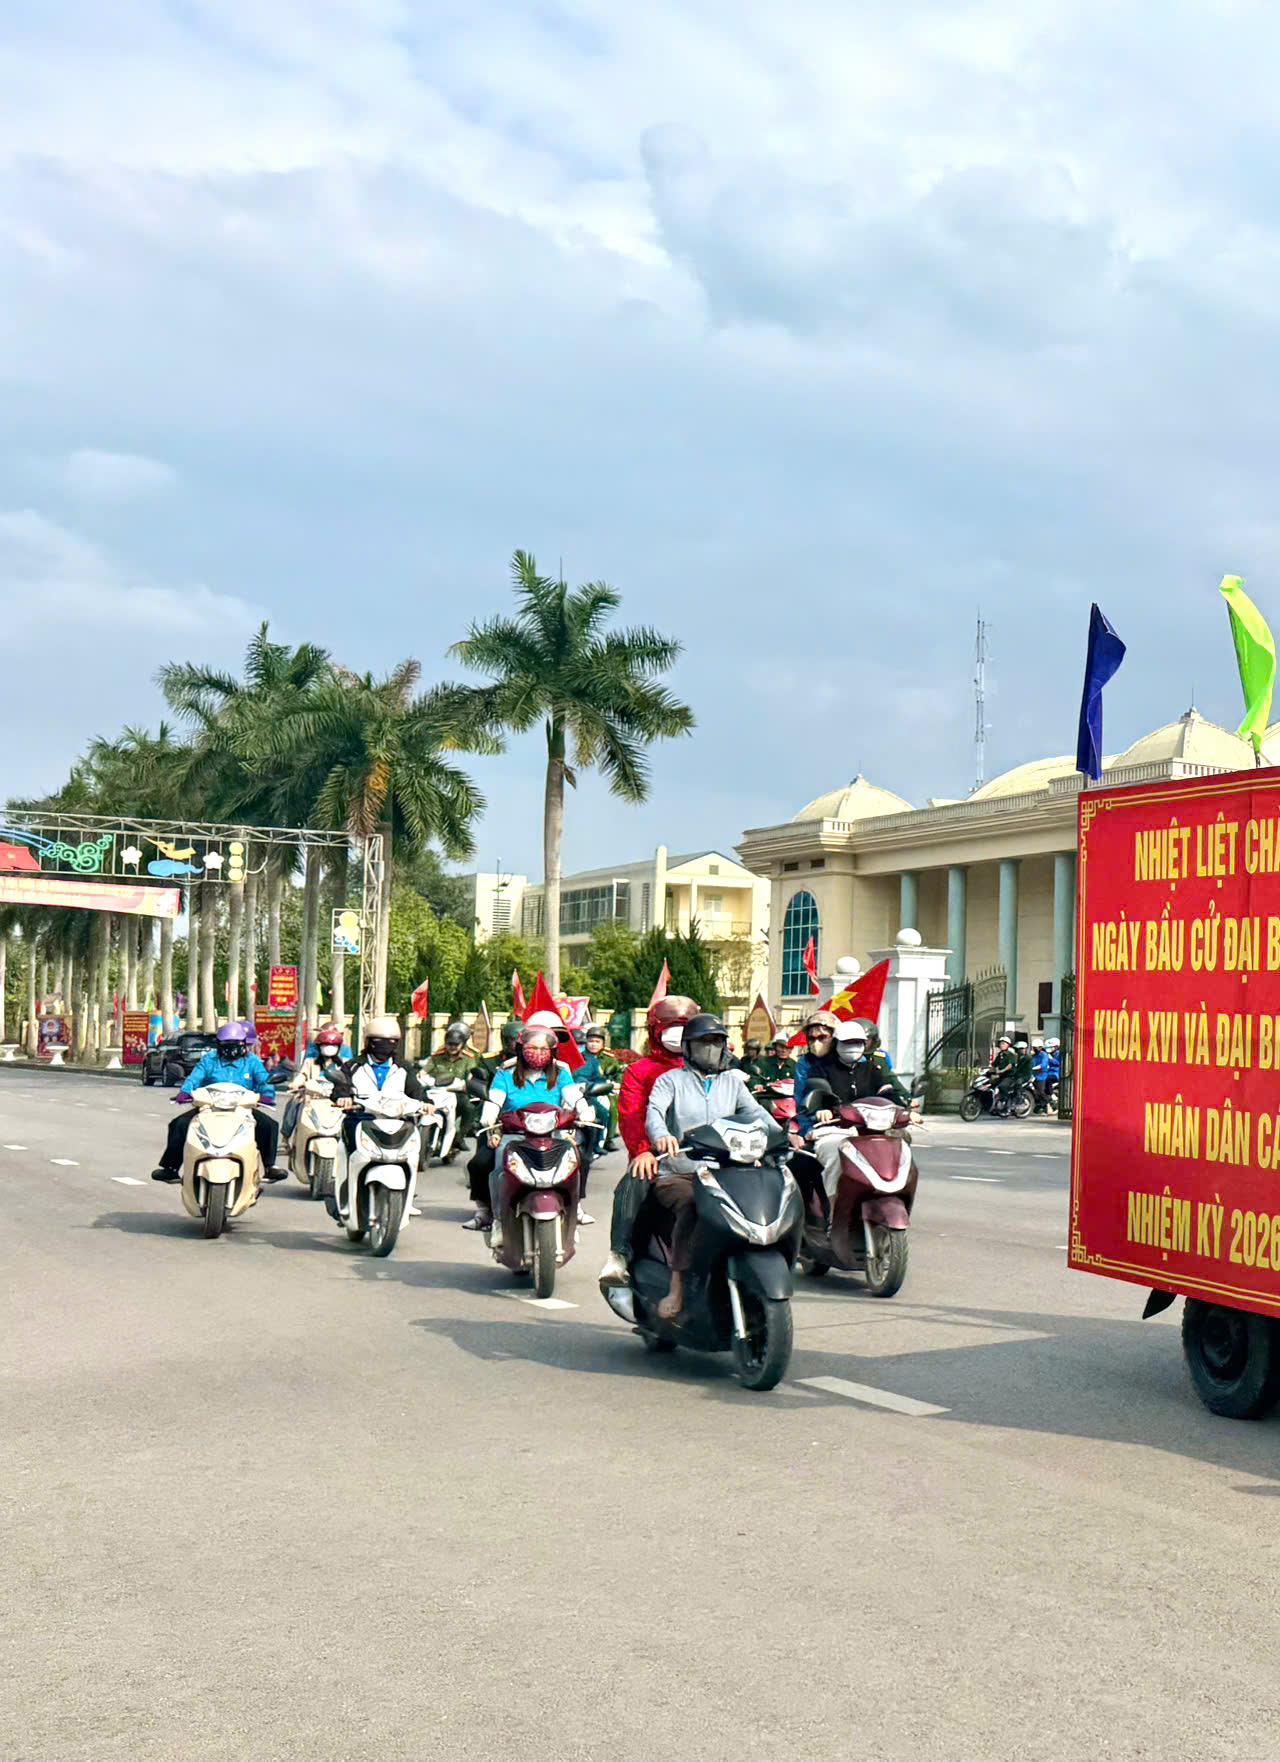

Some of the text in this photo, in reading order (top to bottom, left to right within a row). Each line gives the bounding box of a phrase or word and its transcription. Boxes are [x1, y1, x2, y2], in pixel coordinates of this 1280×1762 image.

[1135, 817, 1191, 891] NHIỆT
[1197, 811, 1238, 888] LIỆT
[1092, 911, 1141, 971] NGÀY
[1145, 901, 1184, 971] BẦU
[1190, 900, 1221, 971] CỬ
[1224, 917, 1260, 984] ĐẠI
[1093, 1000, 1141, 1062] KHÓA
[1147, 1010, 1178, 1063] XVI
[1184, 1001, 1210, 1066] VÀ
[1216, 1013, 1251, 1080] ĐẠI
[1144, 1093, 1200, 1160] NHÂN
[1205, 1098, 1250, 1166] DÂN
[1127, 1185, 1191, 1261] NHIỆM
[1197, 1193, 1224, 1259] KỲ
